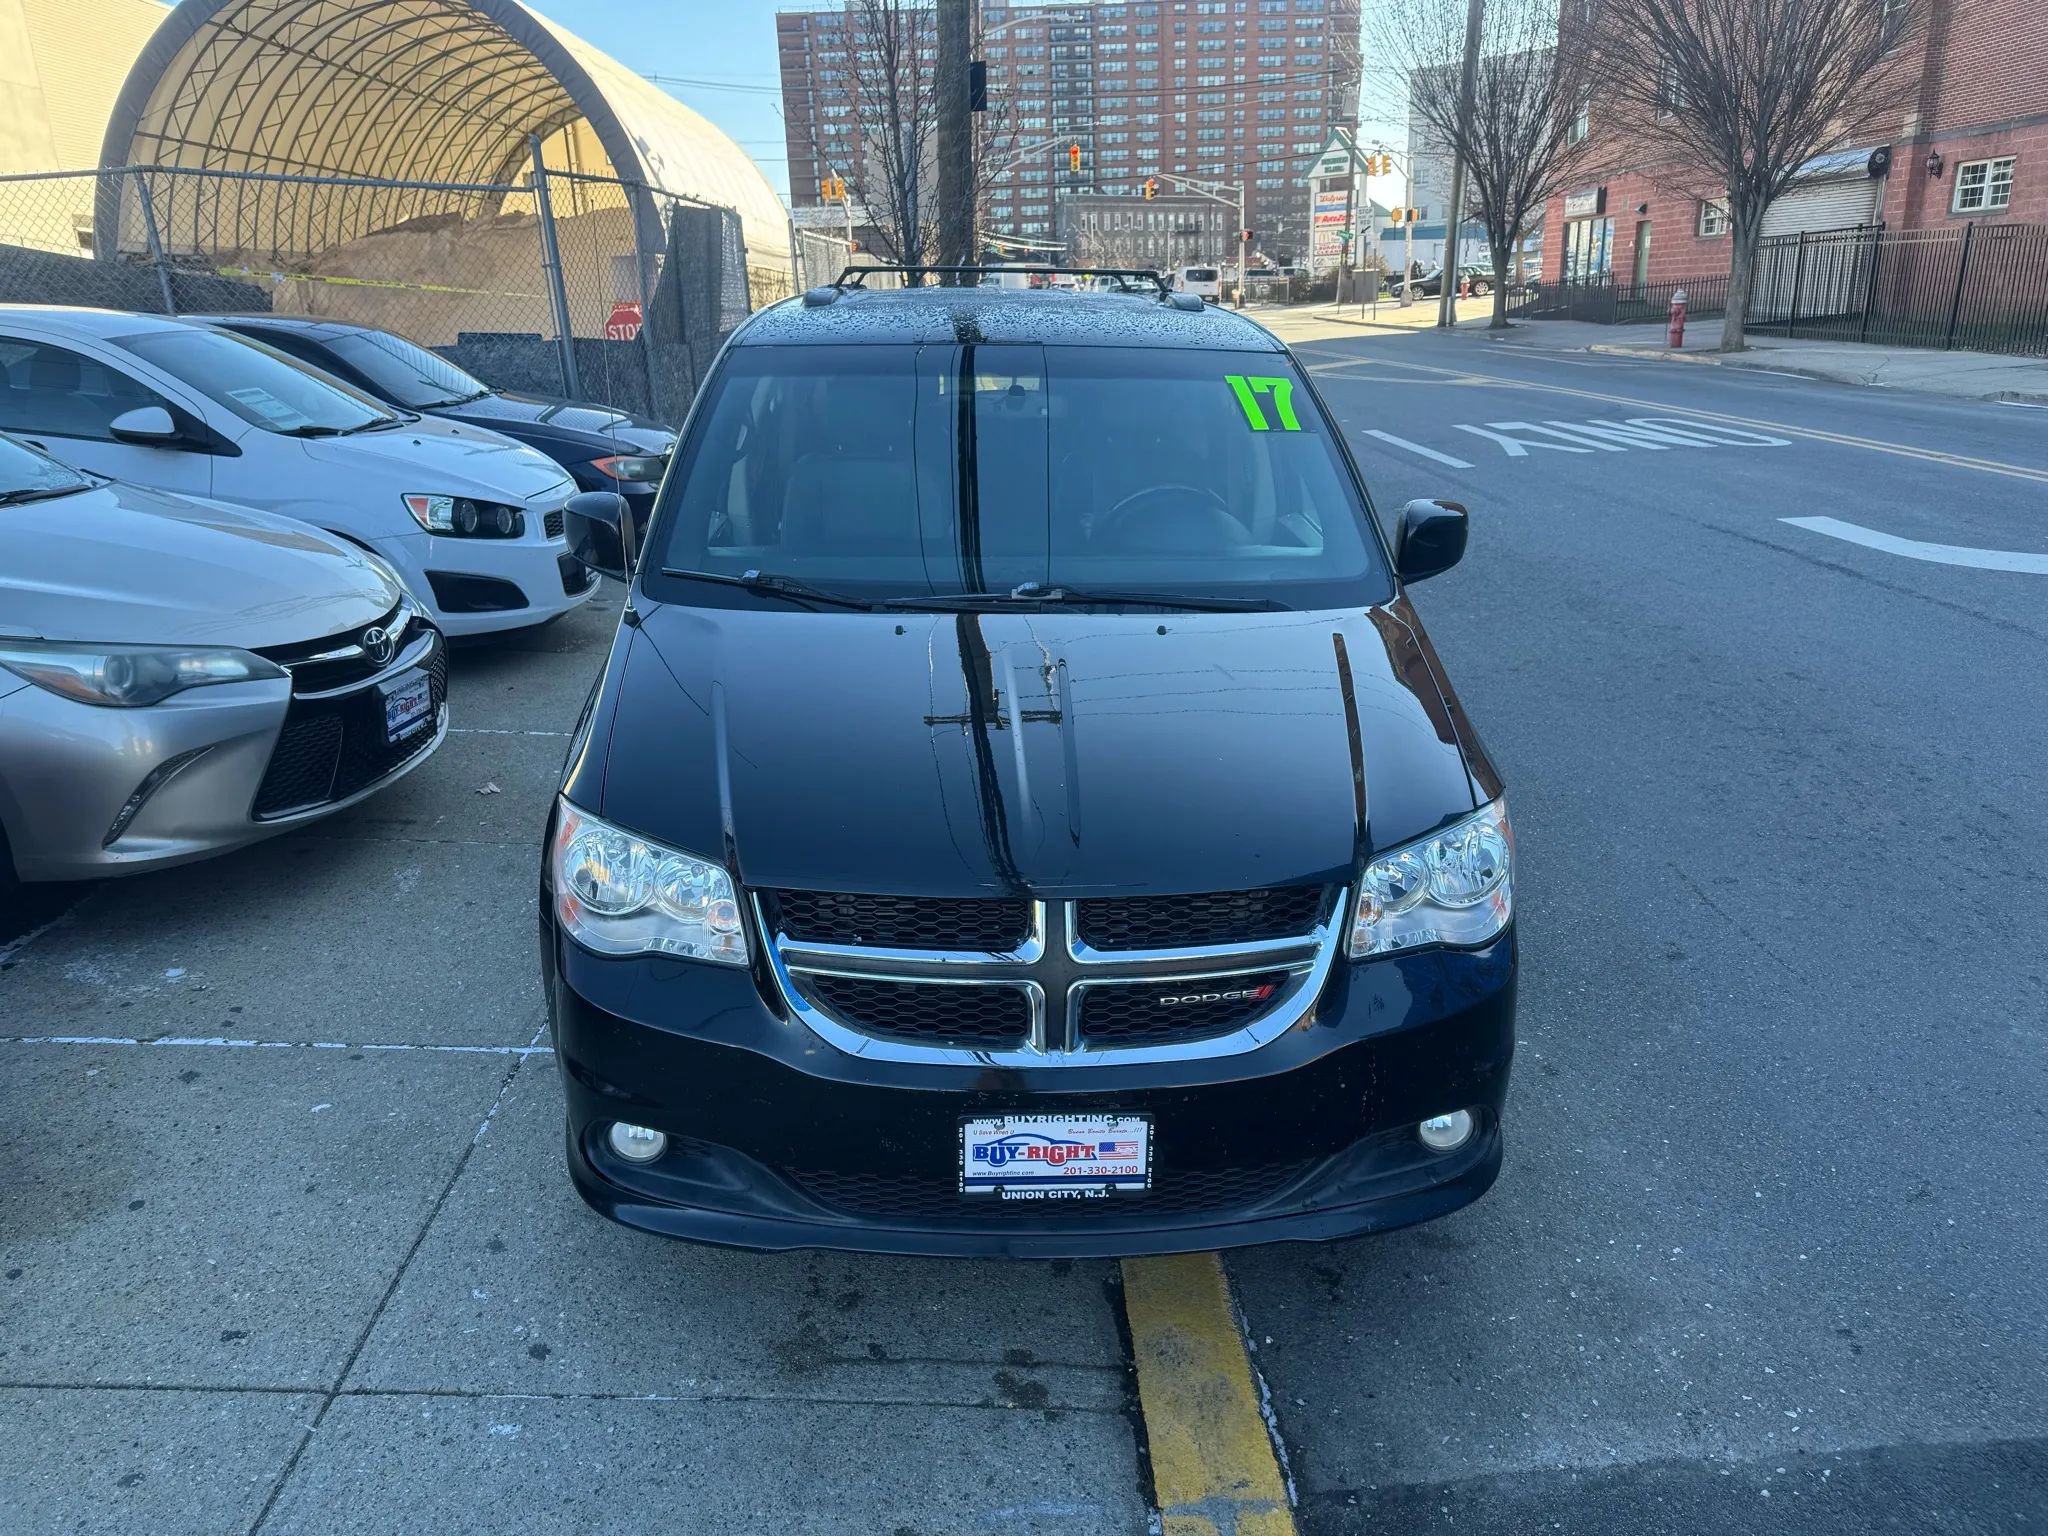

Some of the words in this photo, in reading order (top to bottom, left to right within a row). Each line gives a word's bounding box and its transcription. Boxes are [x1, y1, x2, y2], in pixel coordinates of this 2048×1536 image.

[1225, 375, 1302, 431] 17
[1451, 418, 1793, 456] ONLY
[1160, 989, 1260, 1006] DODGE
[974, 1146, 1096, 1166] BUY-RIGHT
[1063, 1165, 1138, 1175] 201-330-2100
[1001, 1191, 1045, 1200] UNION
[1048, 1189, 1081, 1200] CITY,
[1085, 1189, 1110, 1198] N.J.
